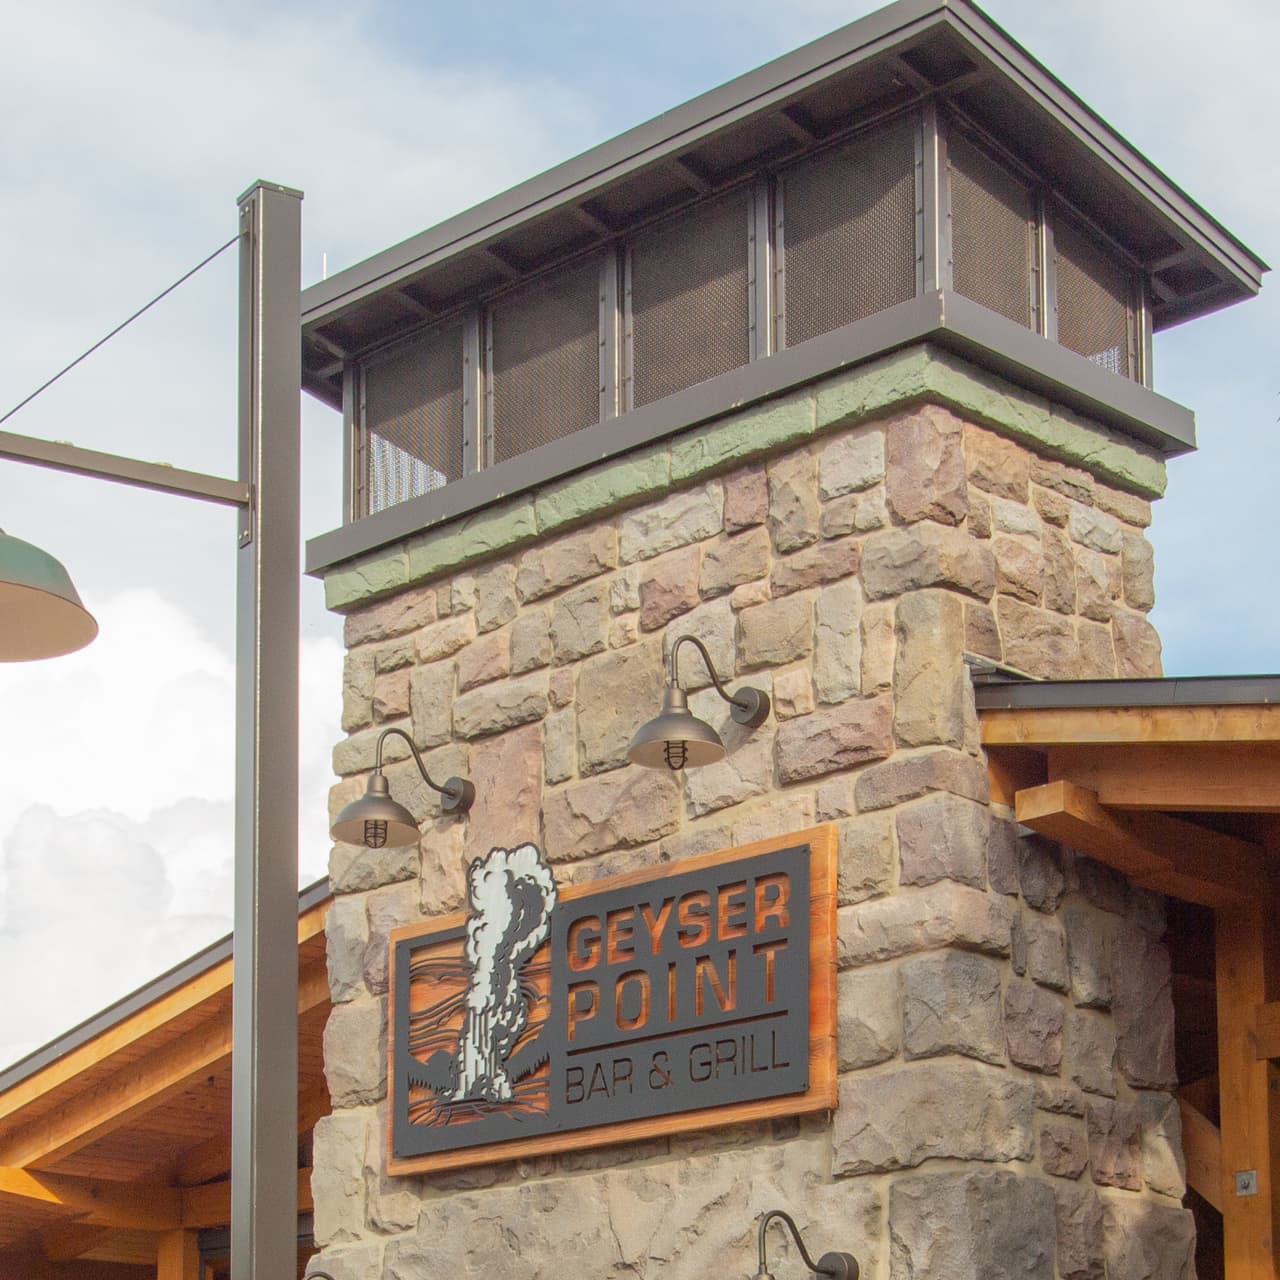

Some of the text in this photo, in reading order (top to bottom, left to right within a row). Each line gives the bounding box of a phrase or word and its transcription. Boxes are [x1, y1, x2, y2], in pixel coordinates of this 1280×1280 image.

[565, 871, 791, 973] GEYSER
[566, 938, 788, 1042] POINT
[565, 1030, 790, 1105] BAR & GRILL
